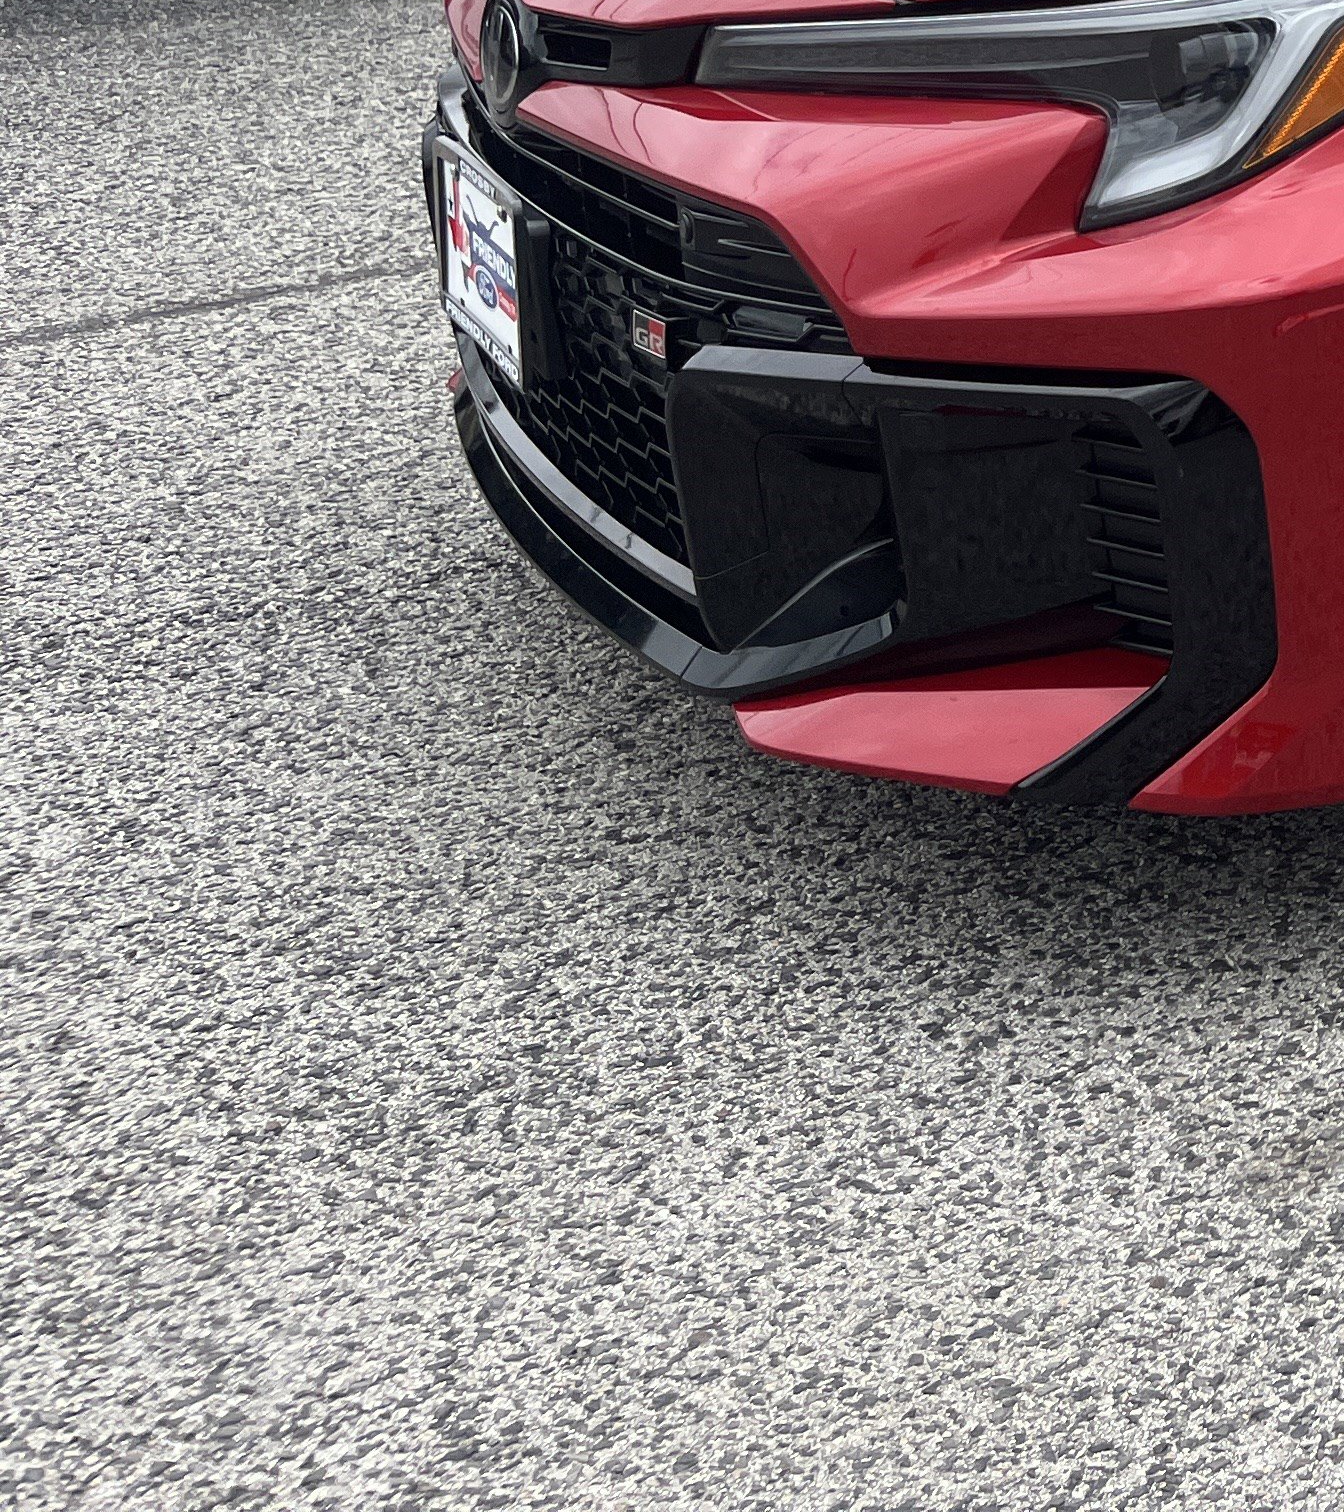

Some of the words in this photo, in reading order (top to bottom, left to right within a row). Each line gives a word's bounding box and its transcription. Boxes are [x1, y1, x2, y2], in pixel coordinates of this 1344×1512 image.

[460, 159, 497, 199] CROSBY
[472, 230, 517, 291] FRIENDLY
[445, 297, 493, 354] FRIENDLY
[492, 342, 520, 382] FORD
[635, 326, 665, 355] GR
